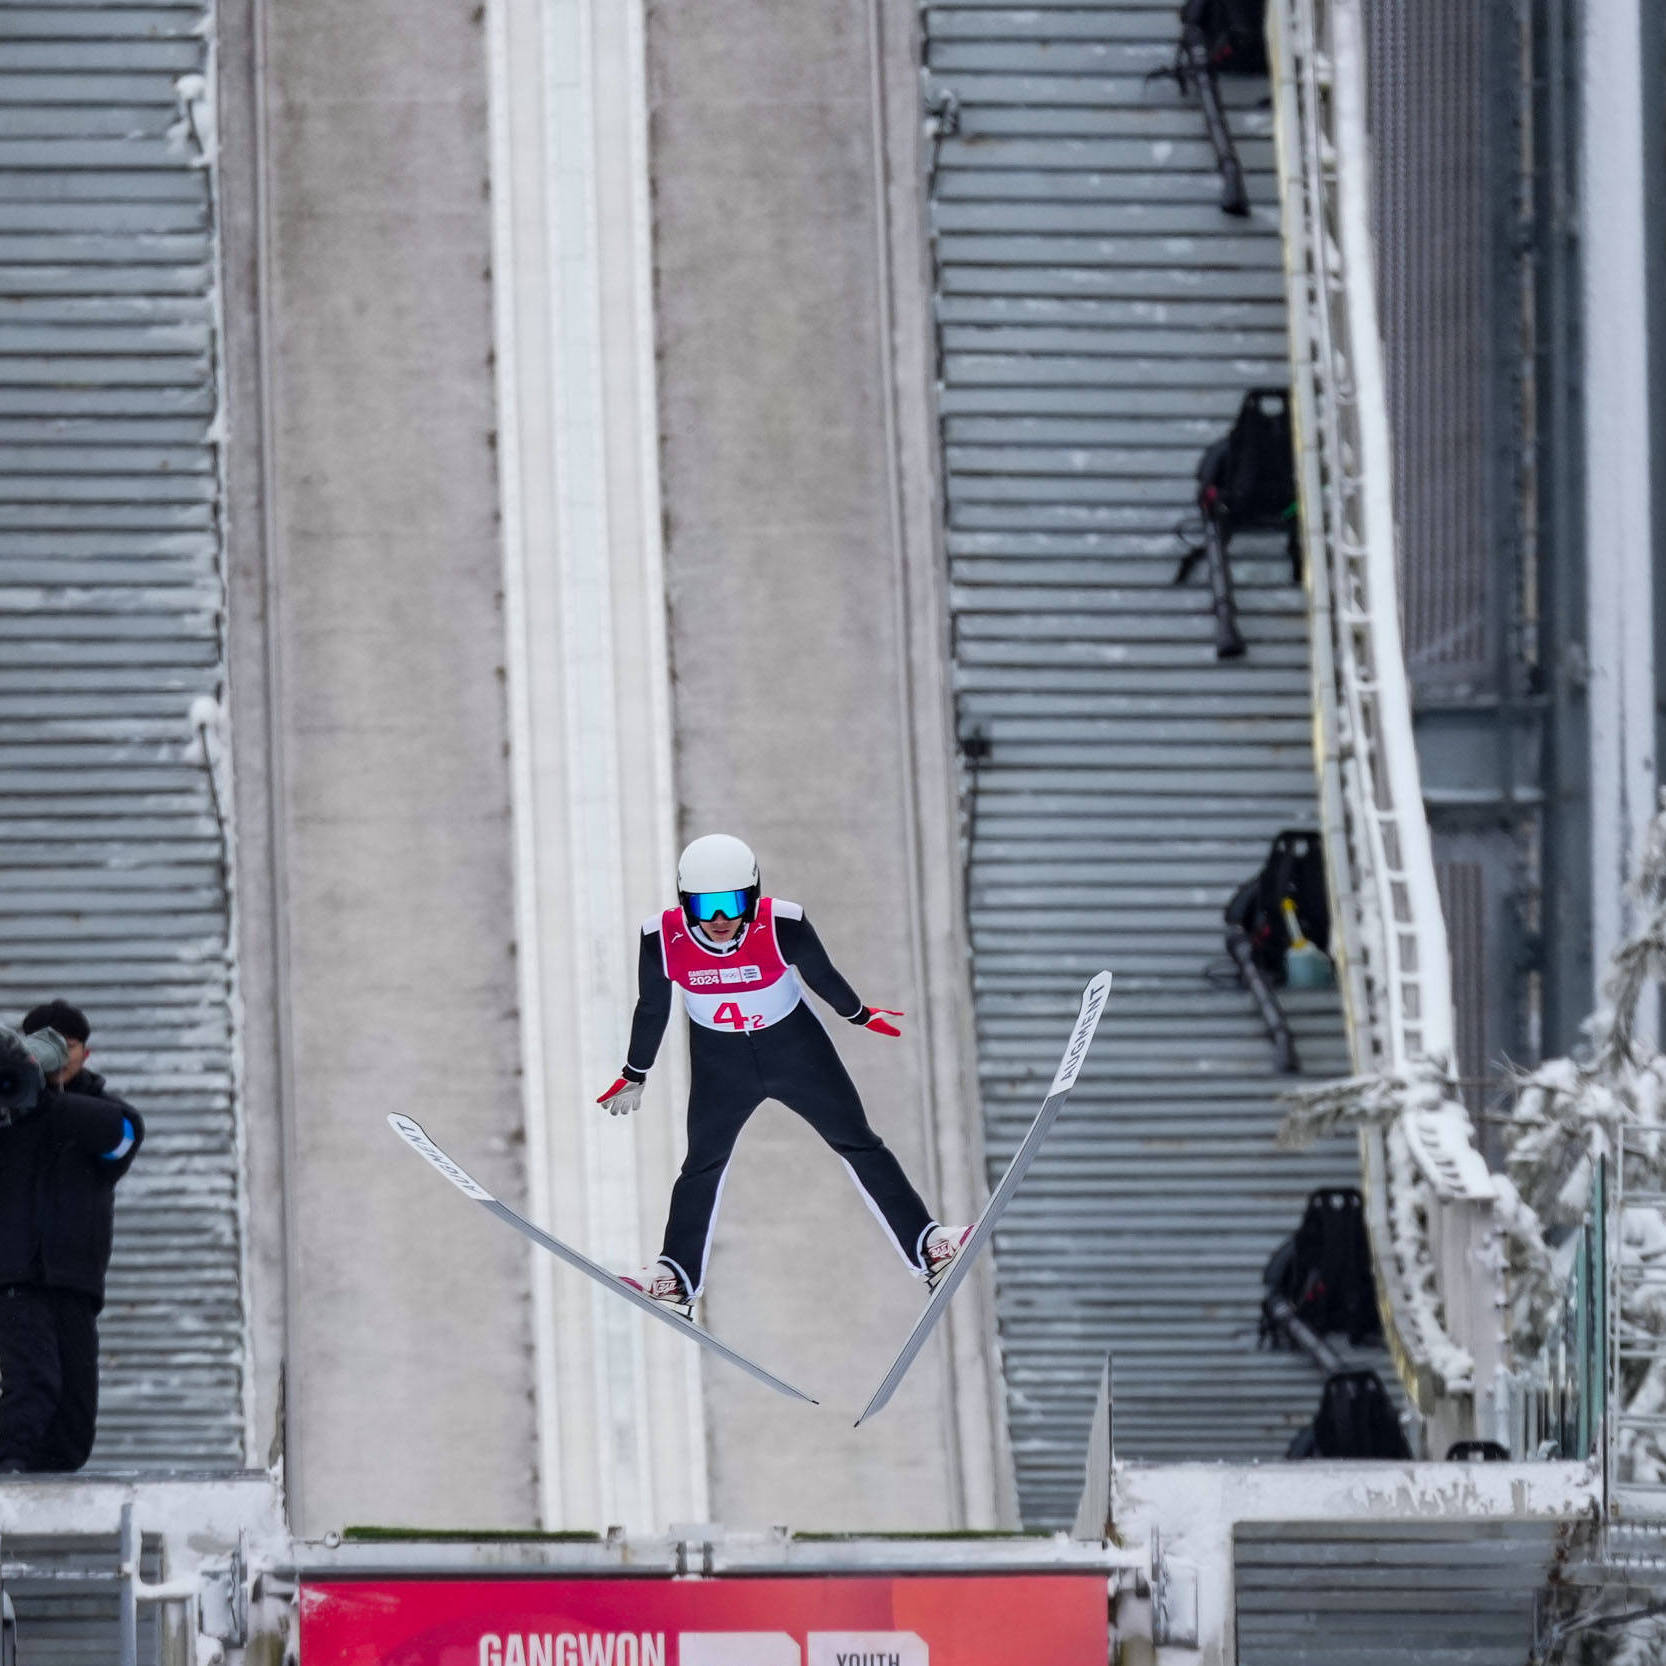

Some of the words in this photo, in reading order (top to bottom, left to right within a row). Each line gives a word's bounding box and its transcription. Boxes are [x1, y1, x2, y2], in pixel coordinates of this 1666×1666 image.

[689, 976, 720, 986] 2024
[713, 1002, 749, 1030] 4
[751, 1014, 765, 1029] 2
[1060, 984, 1105, 1082] AUGMENT
[396, 1121, 482, 1194] AUGMENT
